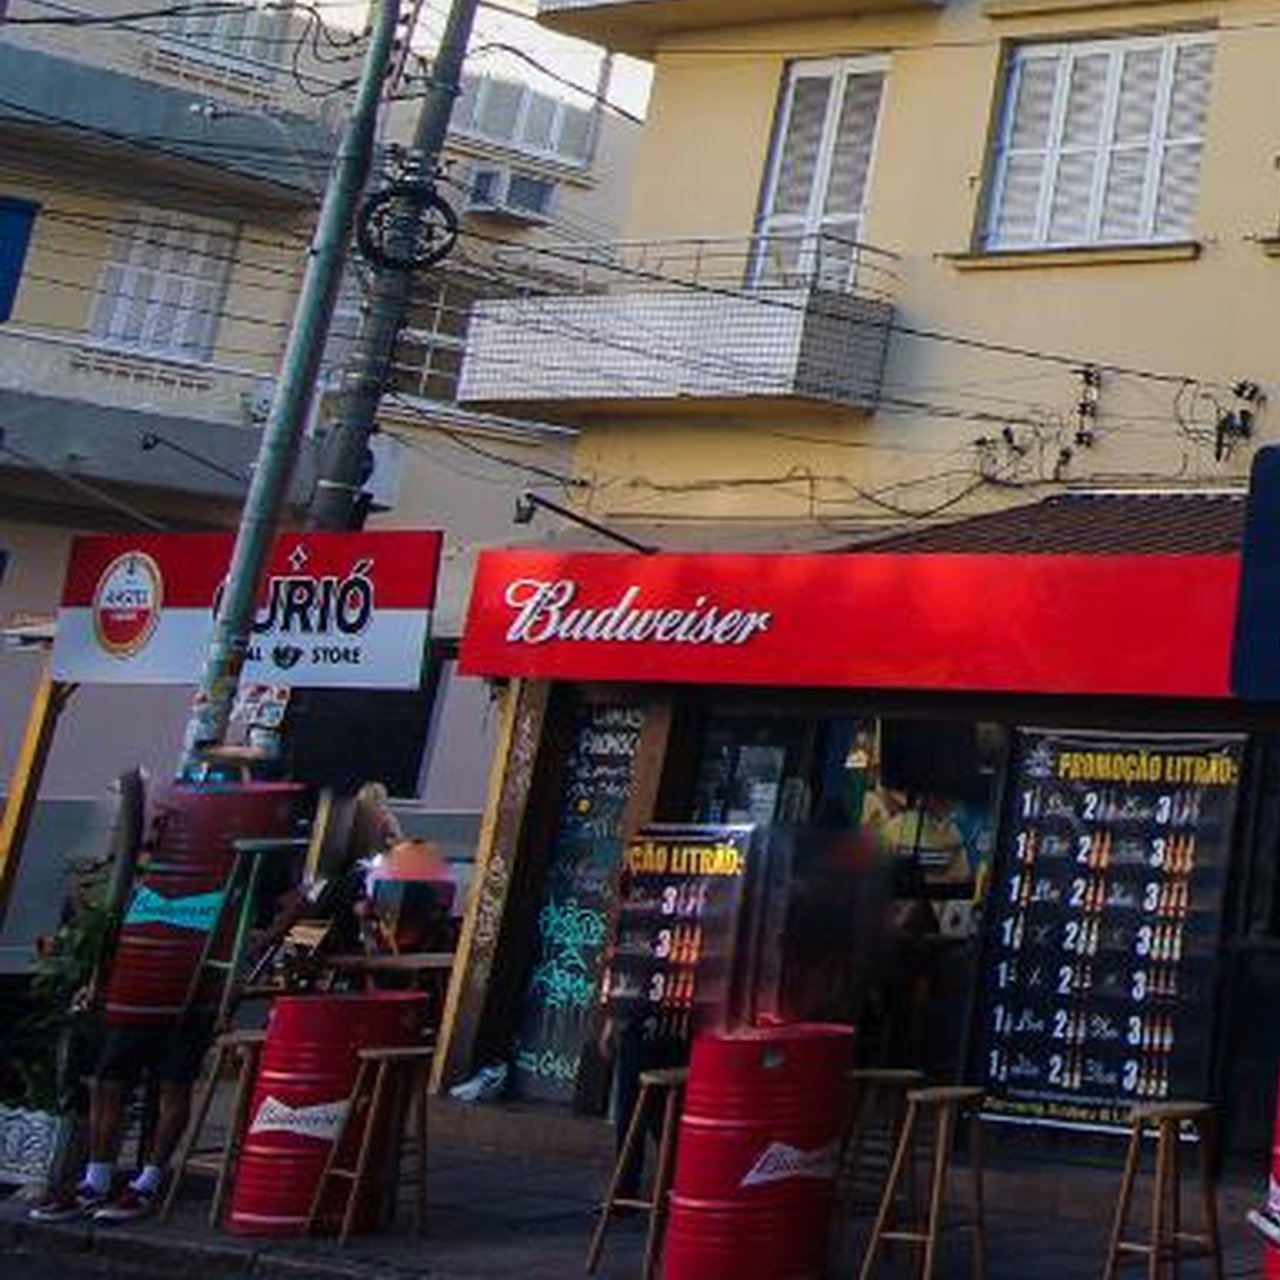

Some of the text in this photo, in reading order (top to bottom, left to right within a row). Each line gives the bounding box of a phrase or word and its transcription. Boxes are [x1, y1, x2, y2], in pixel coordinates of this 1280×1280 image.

[213, 558, 373, 635] URIÓ
[505, 578, 771, 645] Budweiser
[311, 646, 361, 665] STORE
[1059, 750, 1161, 787] PROMOÇÃO
[1083, 792, 1098, 820] 2
[1156, 796, 1172, 825] 3
[1077, 836, 1091, 863] 2
[1151, 838, 1166, 868] 3
[662, 886, 678, 915] 3
[1071, 879, 1087, 906] 2
[1144, 883, 1160, 911] 3
[655, 929, 671, 958] 3
[1063, 922, 1079, 950] 2
[1136, 926, 1151, 956] 3
[1058, 966, 1073, 994] 2
[1132, 971, 1147, 1001] 3
[1053, 1009, 1068, 1038] 2
[1128, 1016, 1142, 1045] 3
[1049, 1055, 1062, 1083] 2
[1123, 1060, 1138, 1091] 3
